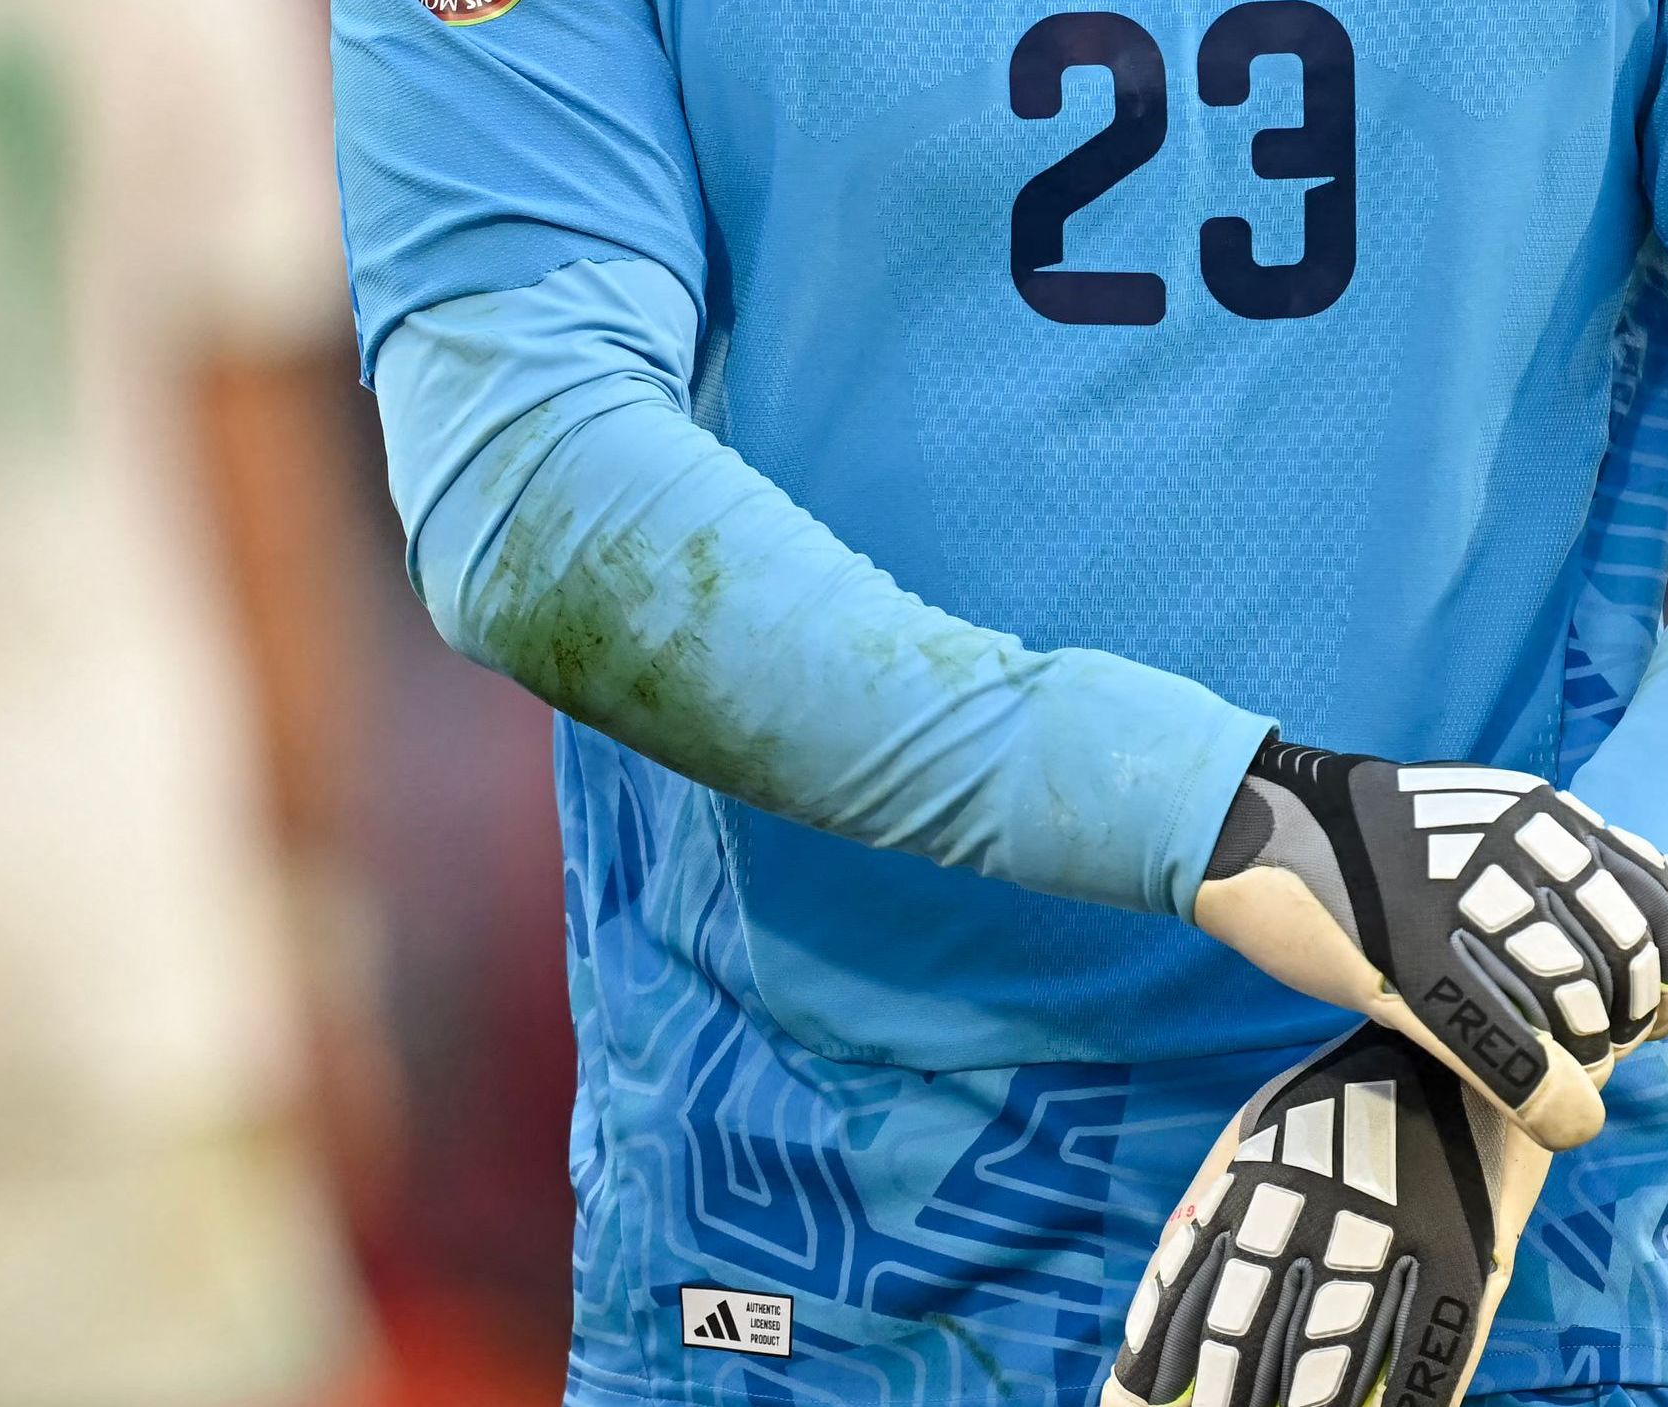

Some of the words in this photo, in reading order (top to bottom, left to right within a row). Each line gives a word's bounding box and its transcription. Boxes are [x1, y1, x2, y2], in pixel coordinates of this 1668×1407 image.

[1008, 0, 1357, 326] 23
[1423, 975, 1543, 1088] PRED
[746, 1301, 781, 1316] AUTHENTIC
[750, 1318, 781, 1331] LICENSED
[750, 1333, 780, 1347] PRODUCT
